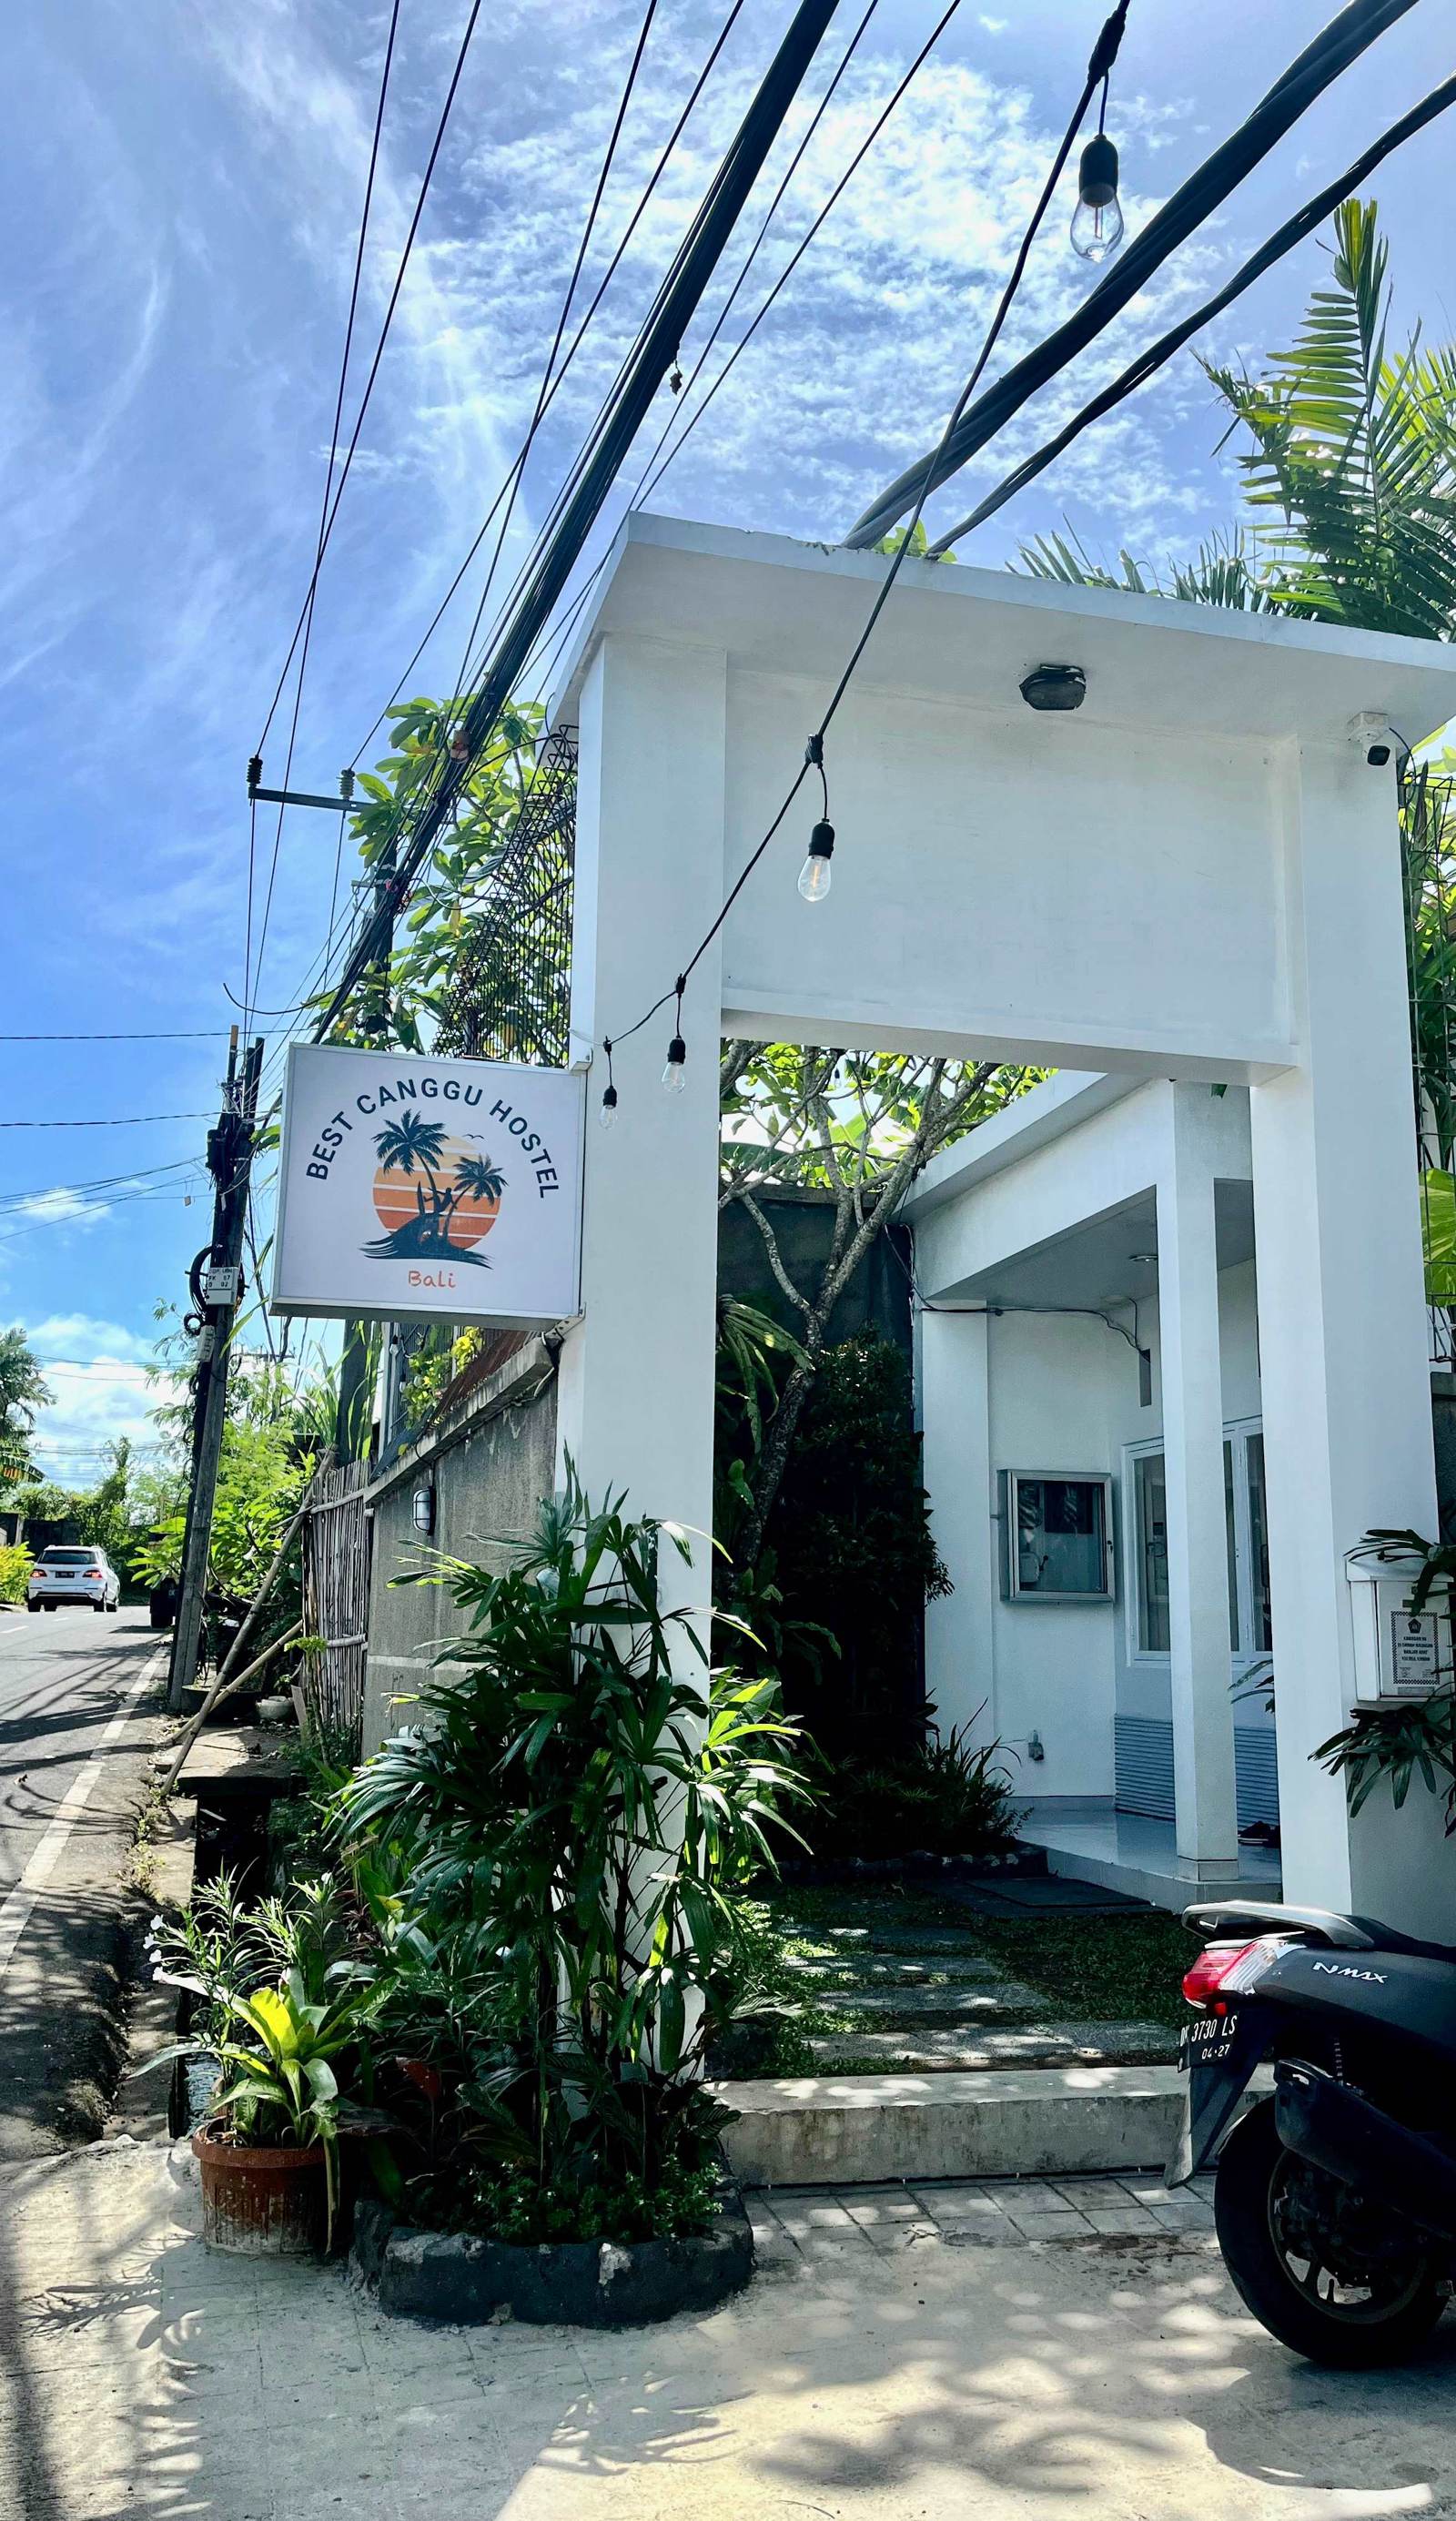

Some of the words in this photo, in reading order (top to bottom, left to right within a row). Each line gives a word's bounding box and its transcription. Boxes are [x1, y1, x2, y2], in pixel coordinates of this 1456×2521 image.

[306, 1111, 354, 1180] BEST
[357, 1078, 483, 1115] CANGGU
[489, 1099, 560, 1199] HOSTEL
[408, 1271, 456, 1288] Bali
[1312, 1961, 1388, 1984] NMAX
[1191, 2019, 1218, 2042] 3730
[1221, 2014, 1238, 2036] LS
